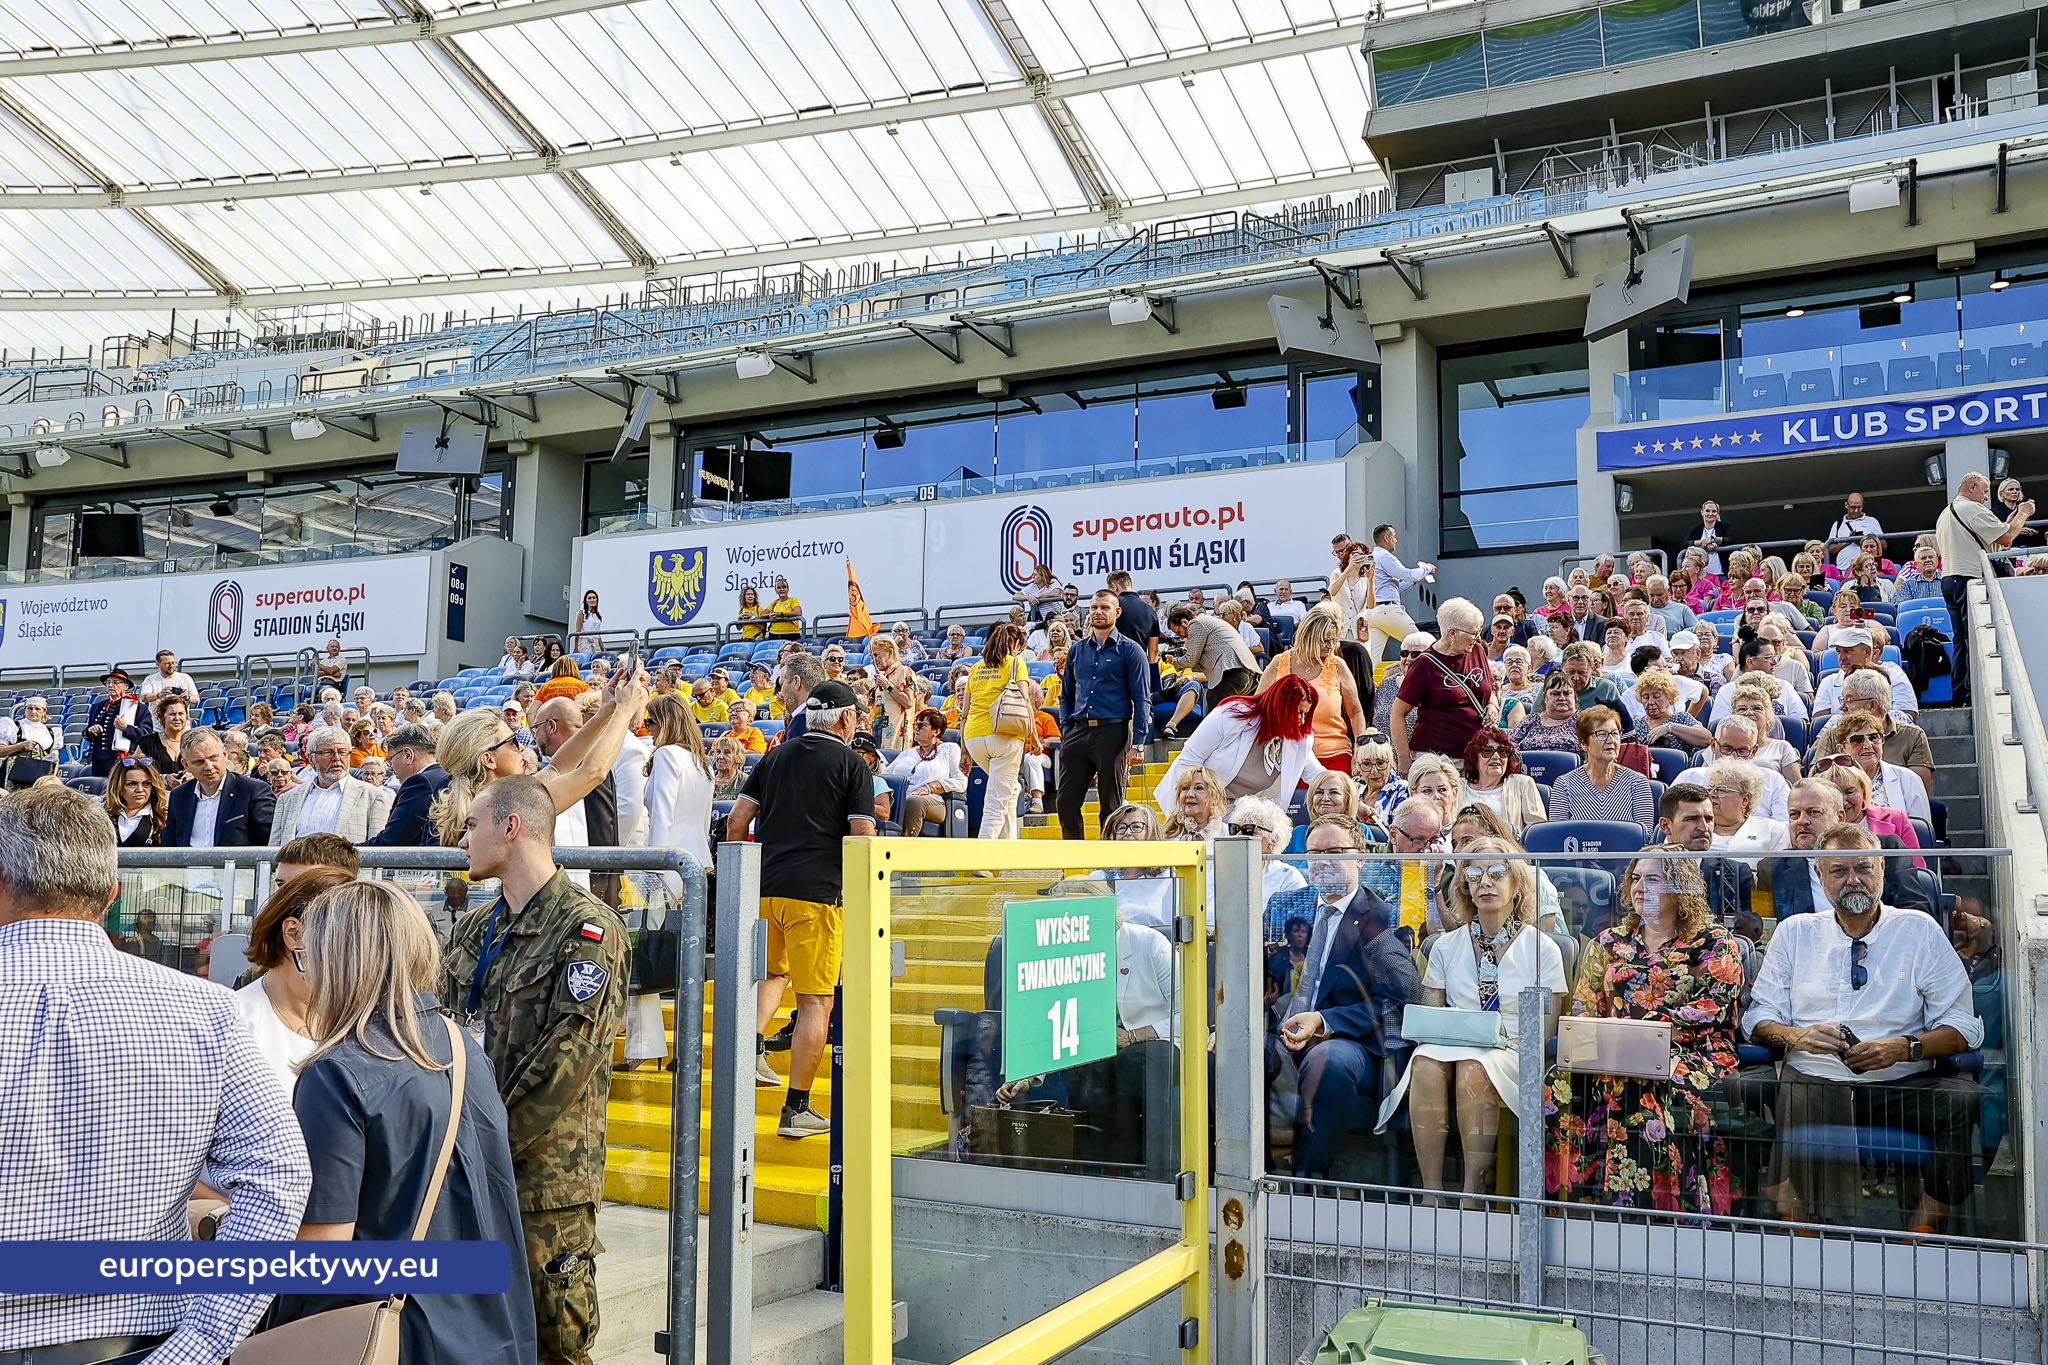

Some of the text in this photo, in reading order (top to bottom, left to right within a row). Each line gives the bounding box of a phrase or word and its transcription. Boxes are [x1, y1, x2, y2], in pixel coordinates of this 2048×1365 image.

[1783, 392, 2048, 445] KLUB SPORT
[920, 486, 935, 500] 09
[1072, 501, 1245, 541] superauto.pl
[163, 561, 175, 573] 08
[726, 540, 844, 567] Województwo
[1072, 538, 1246, 576] STADION ŚLĄSKI
[20, 597, 108, 617] Województwo
[256, 583, 366, 611] superauto.pl
[18, 621, 63, 641] Śląskie
[253, 610, 365, 639] STADION ŚLĄSKI
[1036, 912, 1090, 947] WYJŚCIE
[1017, 952, 1106, 992] EWAKUACYJNE
[1047, 997, 1080, 1061] 14
